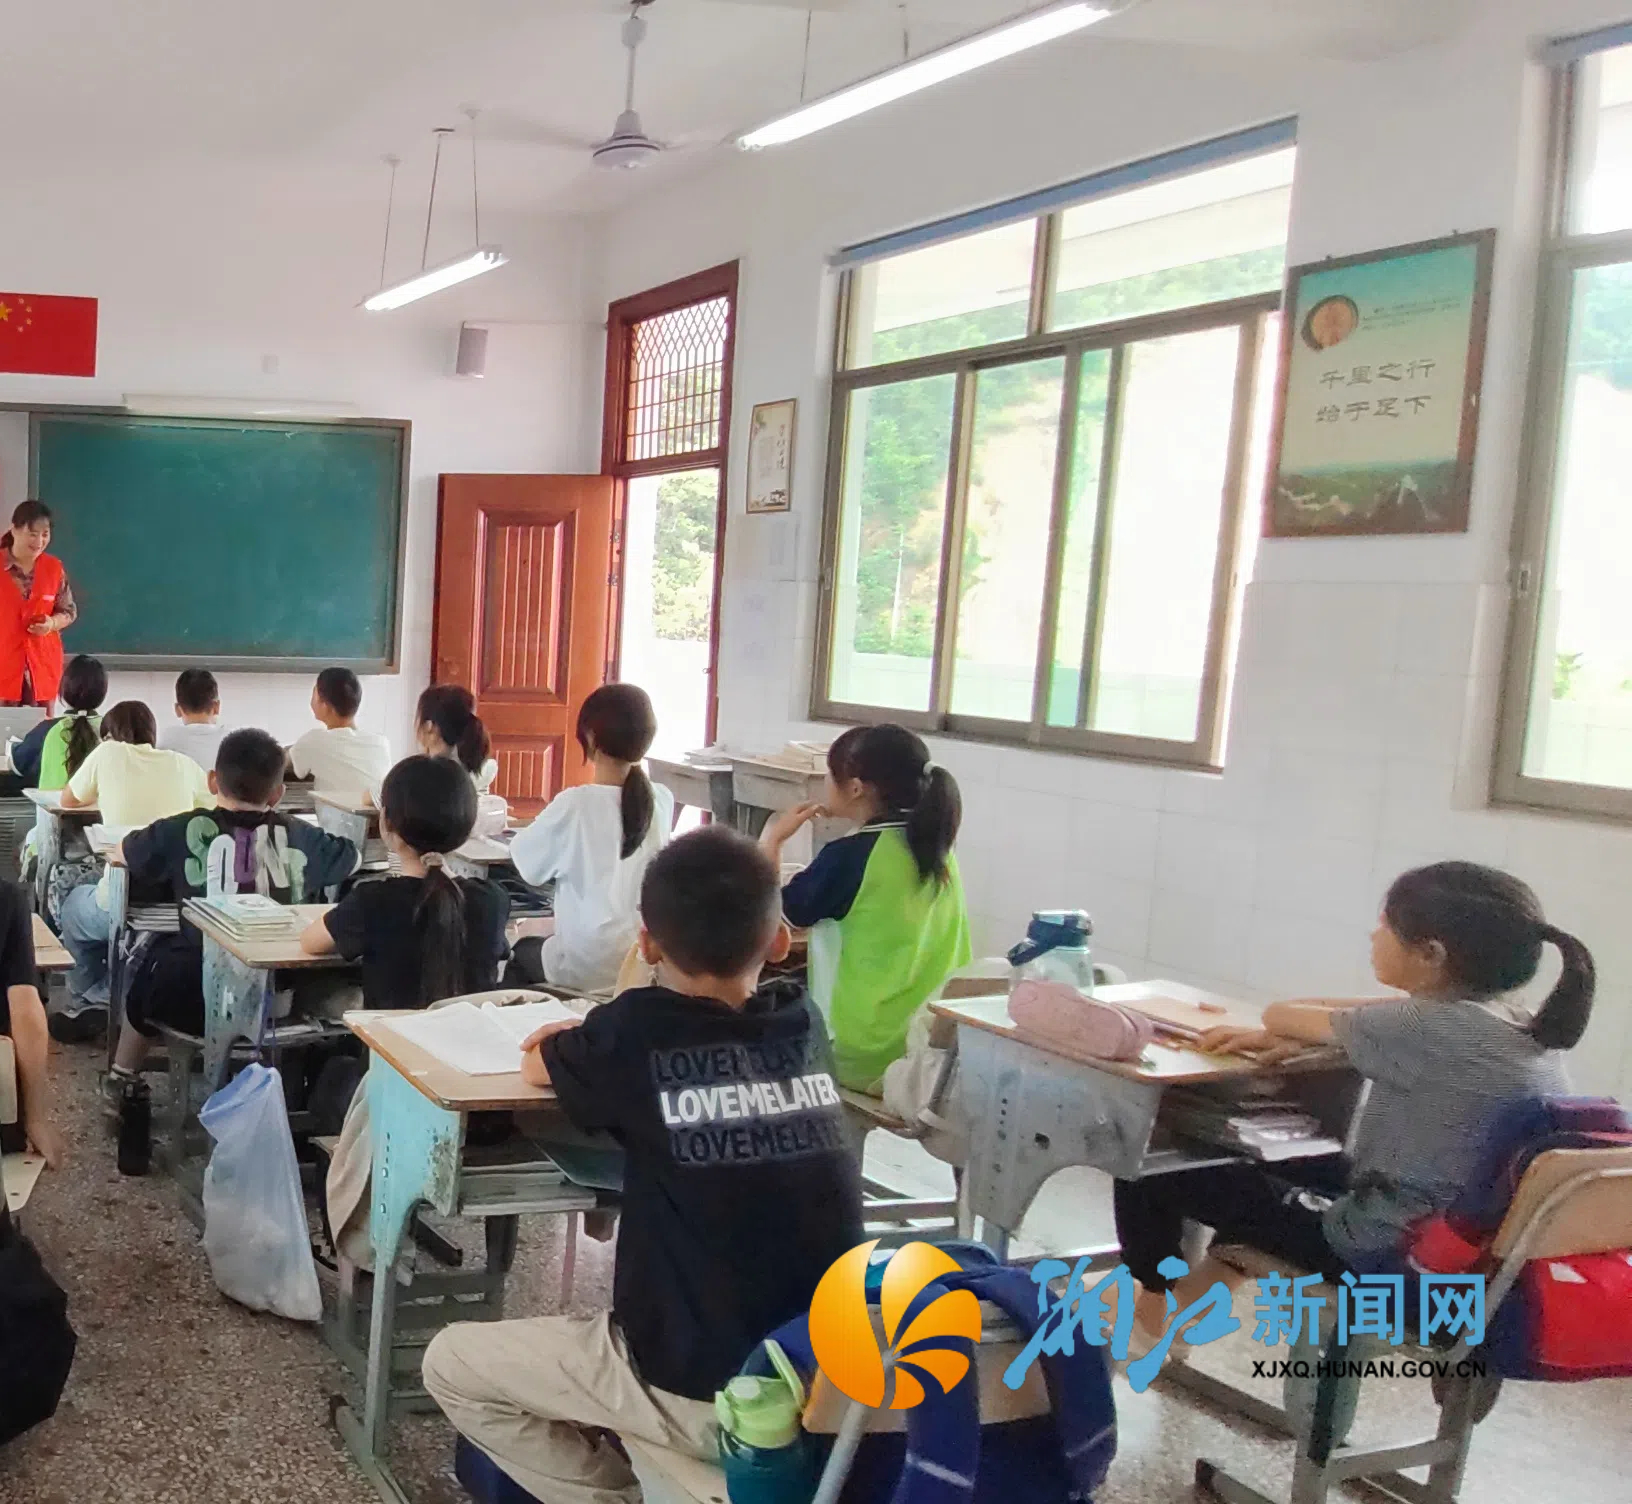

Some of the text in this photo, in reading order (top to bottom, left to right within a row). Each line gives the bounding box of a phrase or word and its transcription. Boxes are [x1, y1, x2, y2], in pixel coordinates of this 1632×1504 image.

[1319, 358, 1436, 390] 千里之行
[1315, 394, 1432, 424] 始于足下
[660, 1073, 840, 1124] LOVEMELATER
